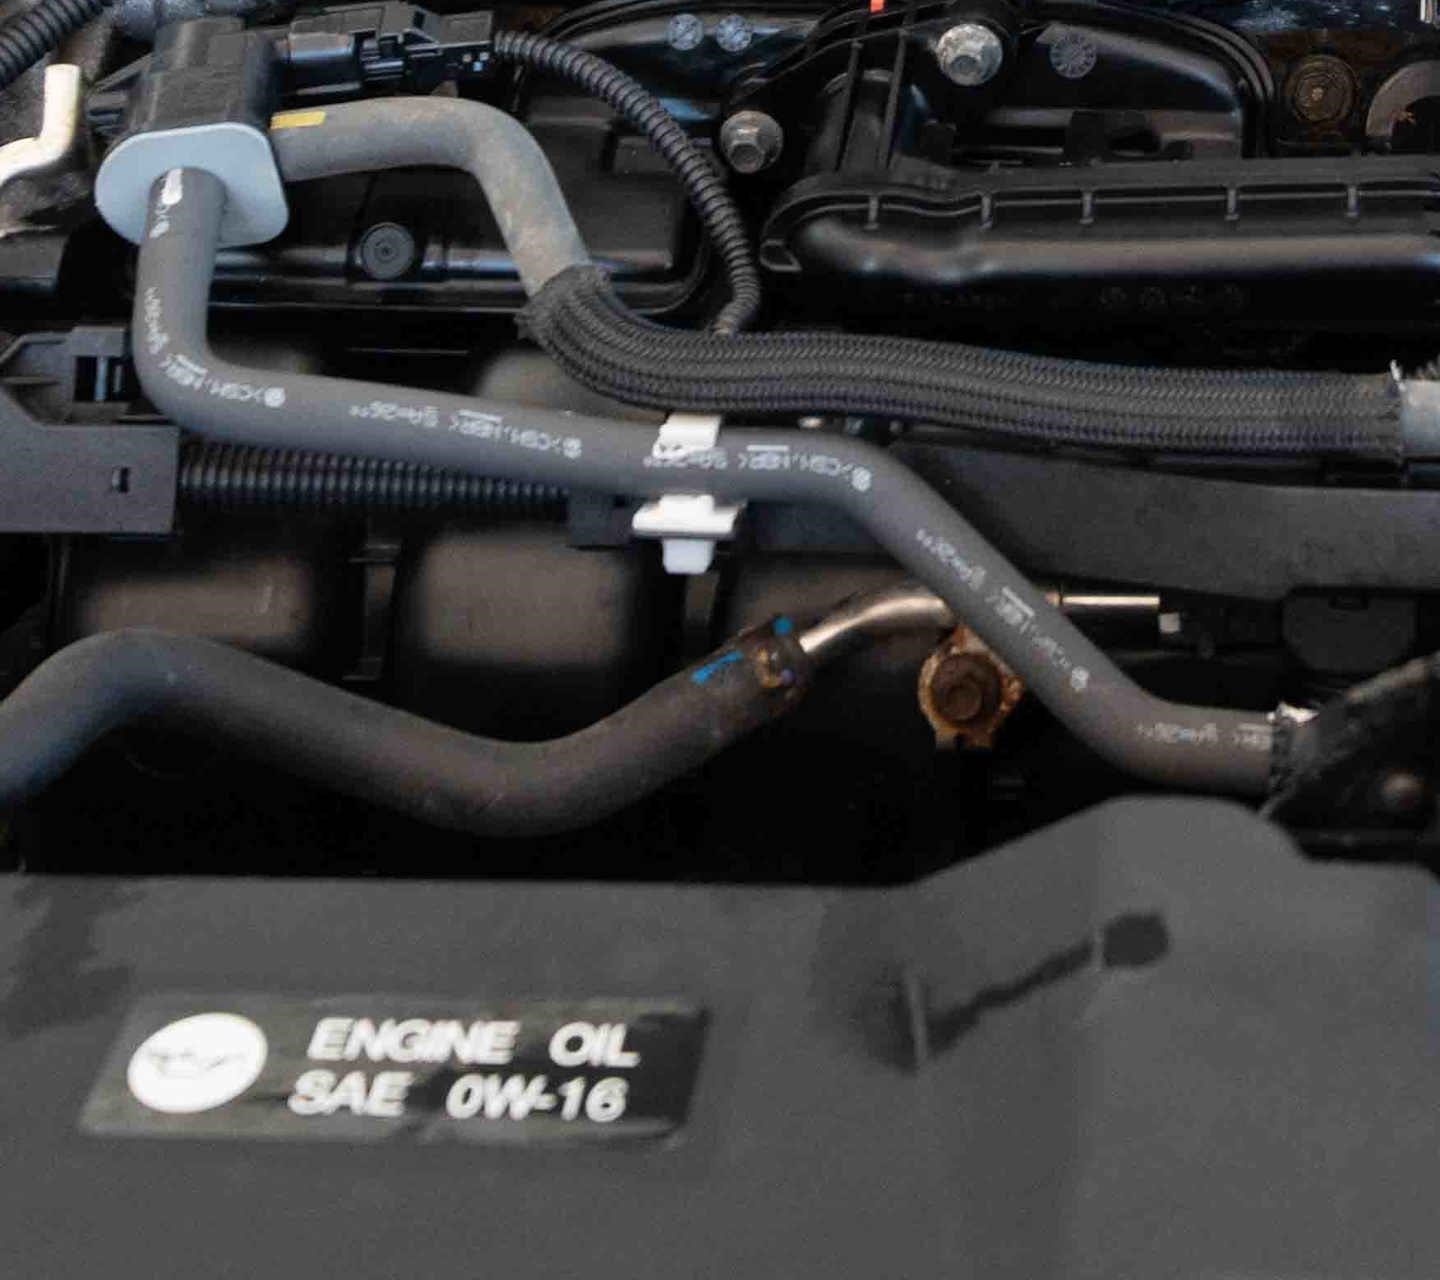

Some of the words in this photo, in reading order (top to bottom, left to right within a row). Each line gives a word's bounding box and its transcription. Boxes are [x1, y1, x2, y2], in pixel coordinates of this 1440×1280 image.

[306, 1016, 522, 1065] ENGINE
[548, 1021, 640, 1068] OIL
[287, 1069, 413, 1118] SAE
[445, 1073, 630, 1123] 0W-16
